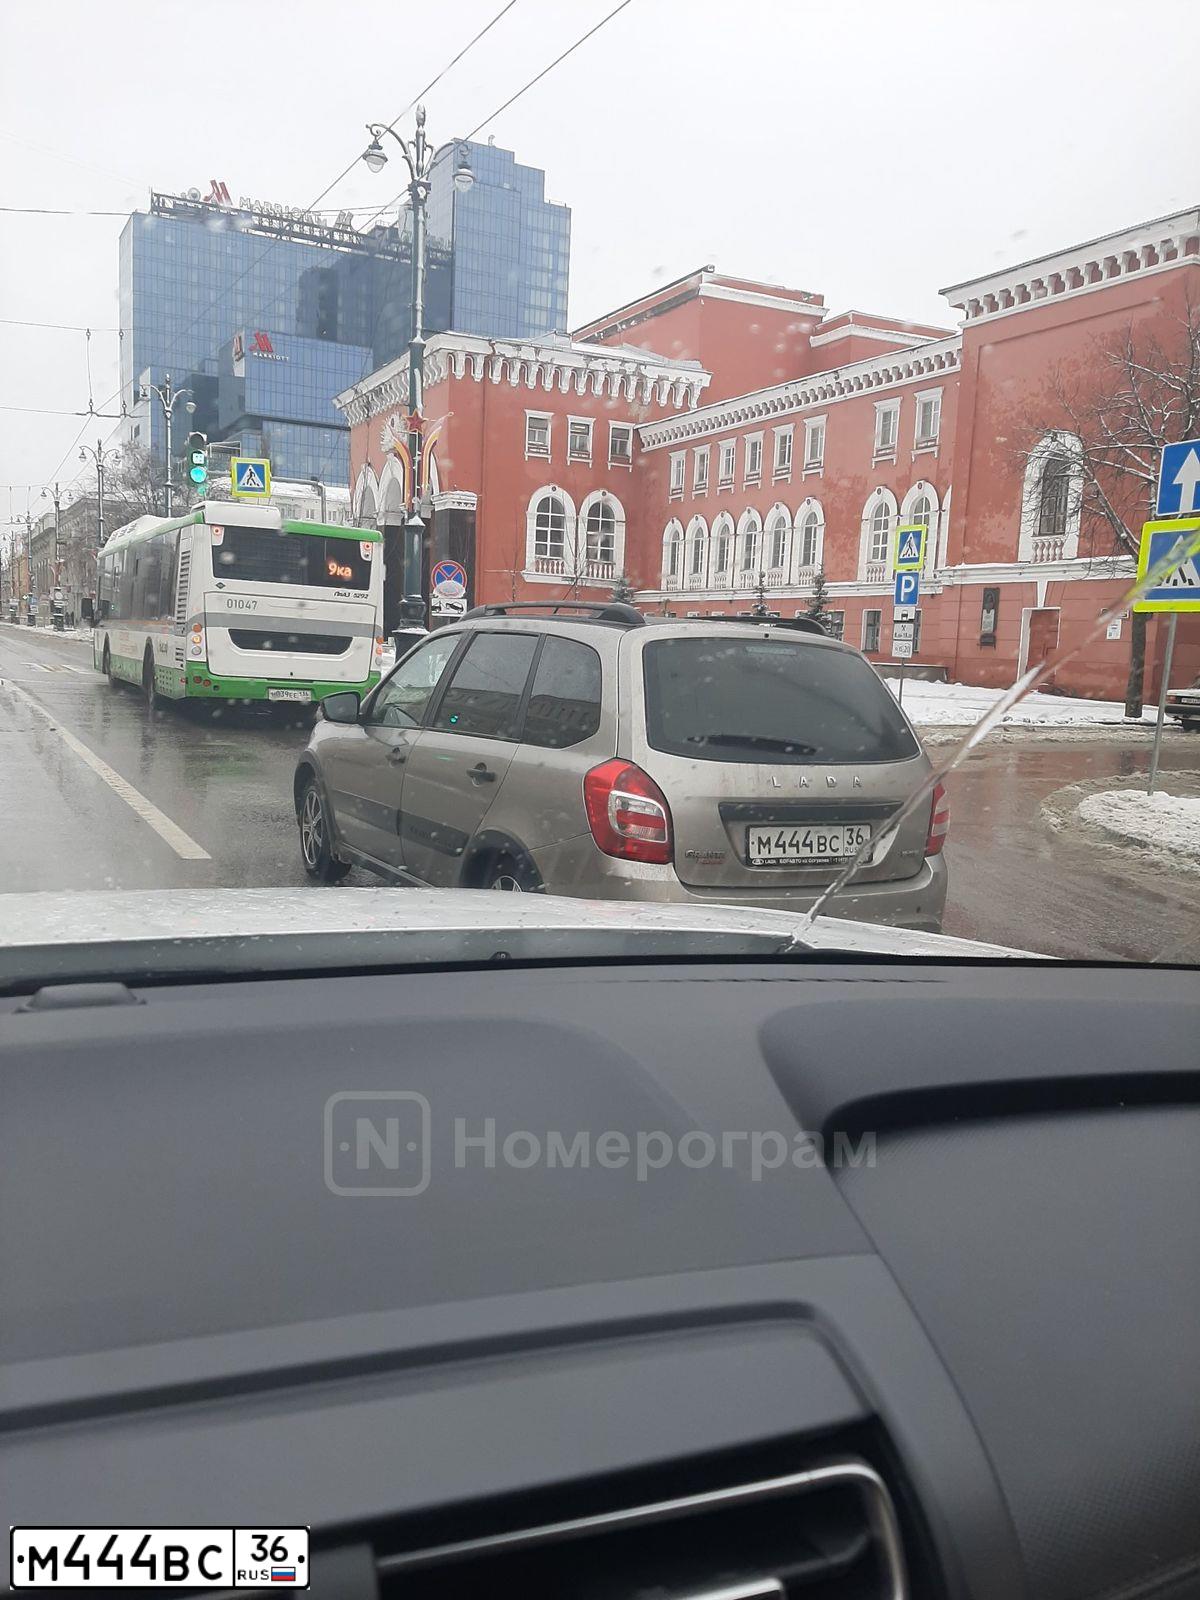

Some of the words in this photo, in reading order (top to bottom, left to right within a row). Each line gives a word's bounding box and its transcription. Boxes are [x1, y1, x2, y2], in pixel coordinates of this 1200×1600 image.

[239, 196, 322, 224] MARRIOTT
[900, 575, 915, 602] P
[226, 598, 258, 610] 01047
[771, 775, 863, 789] LADA
[756, 829, 840, 855] М444ВС
[845, 827, 864, 847] 36
